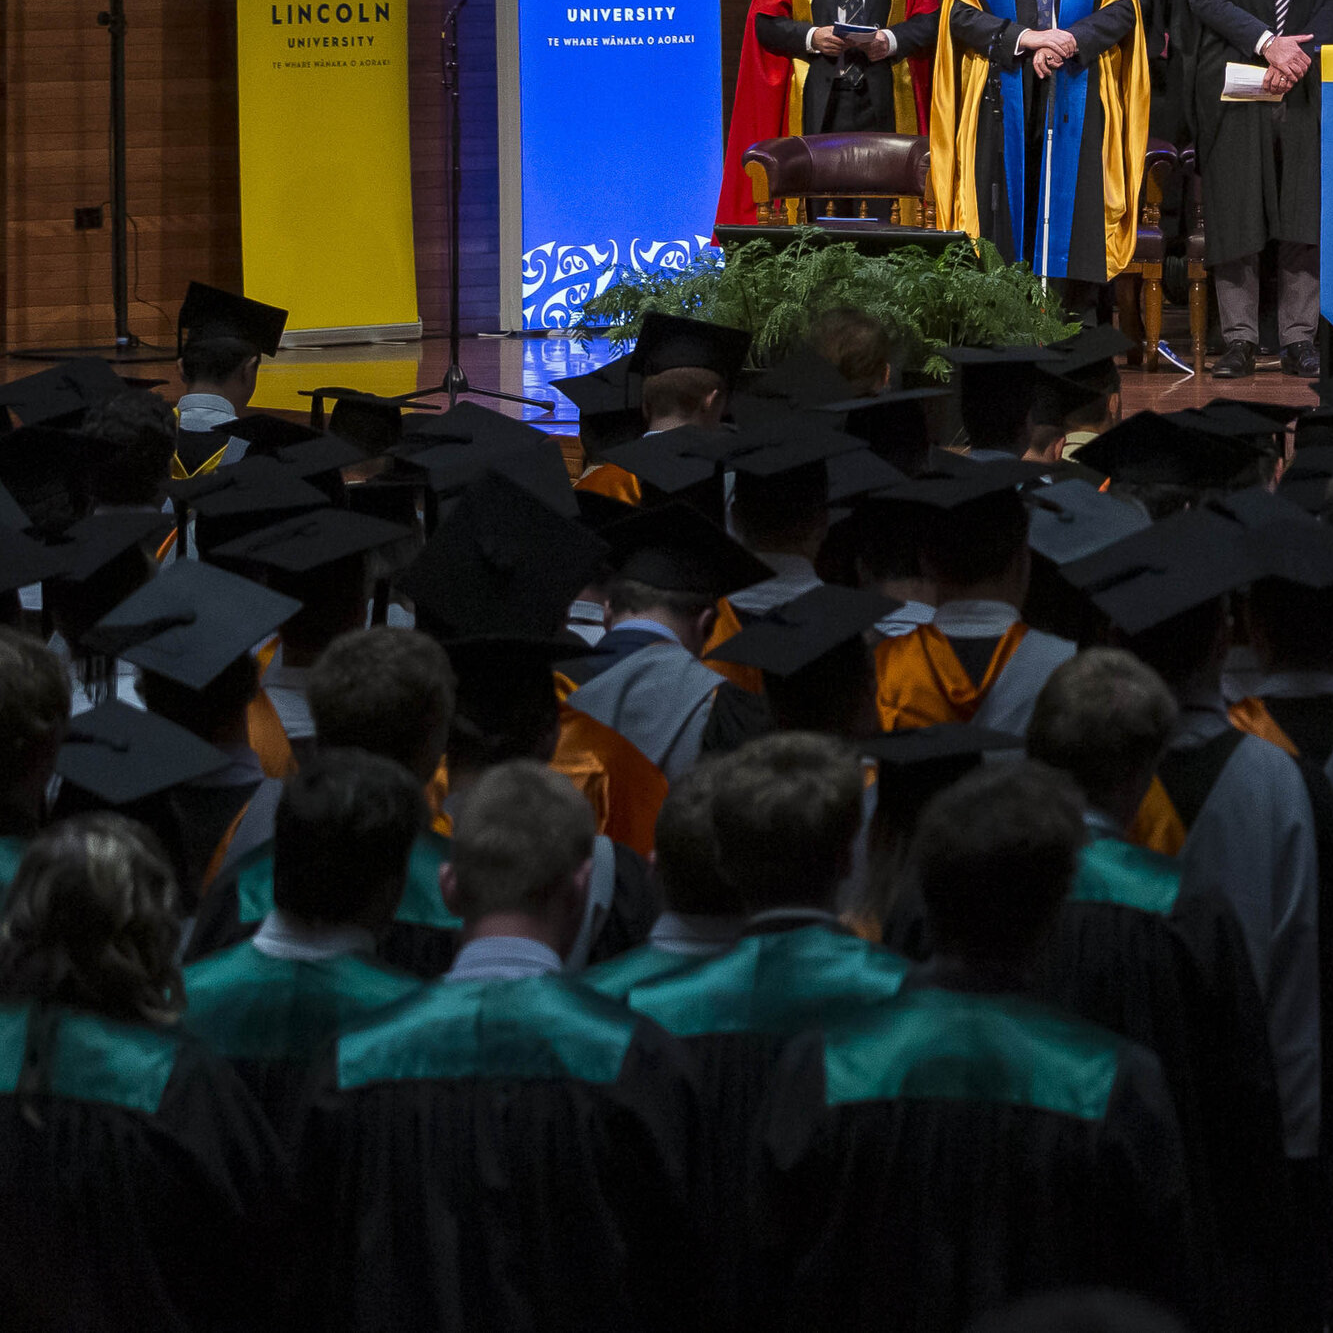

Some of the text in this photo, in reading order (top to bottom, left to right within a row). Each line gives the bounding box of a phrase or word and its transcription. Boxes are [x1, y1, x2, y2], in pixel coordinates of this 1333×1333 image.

[271, 2, 390, 25] LINCOLN
[567, 6, 676, 23] UNIVERSITY
[287, 35, 375, 49] UNIVERSITY
[547, 34, 695, 47] TE WHARE WĀNAKA O AORAKI
